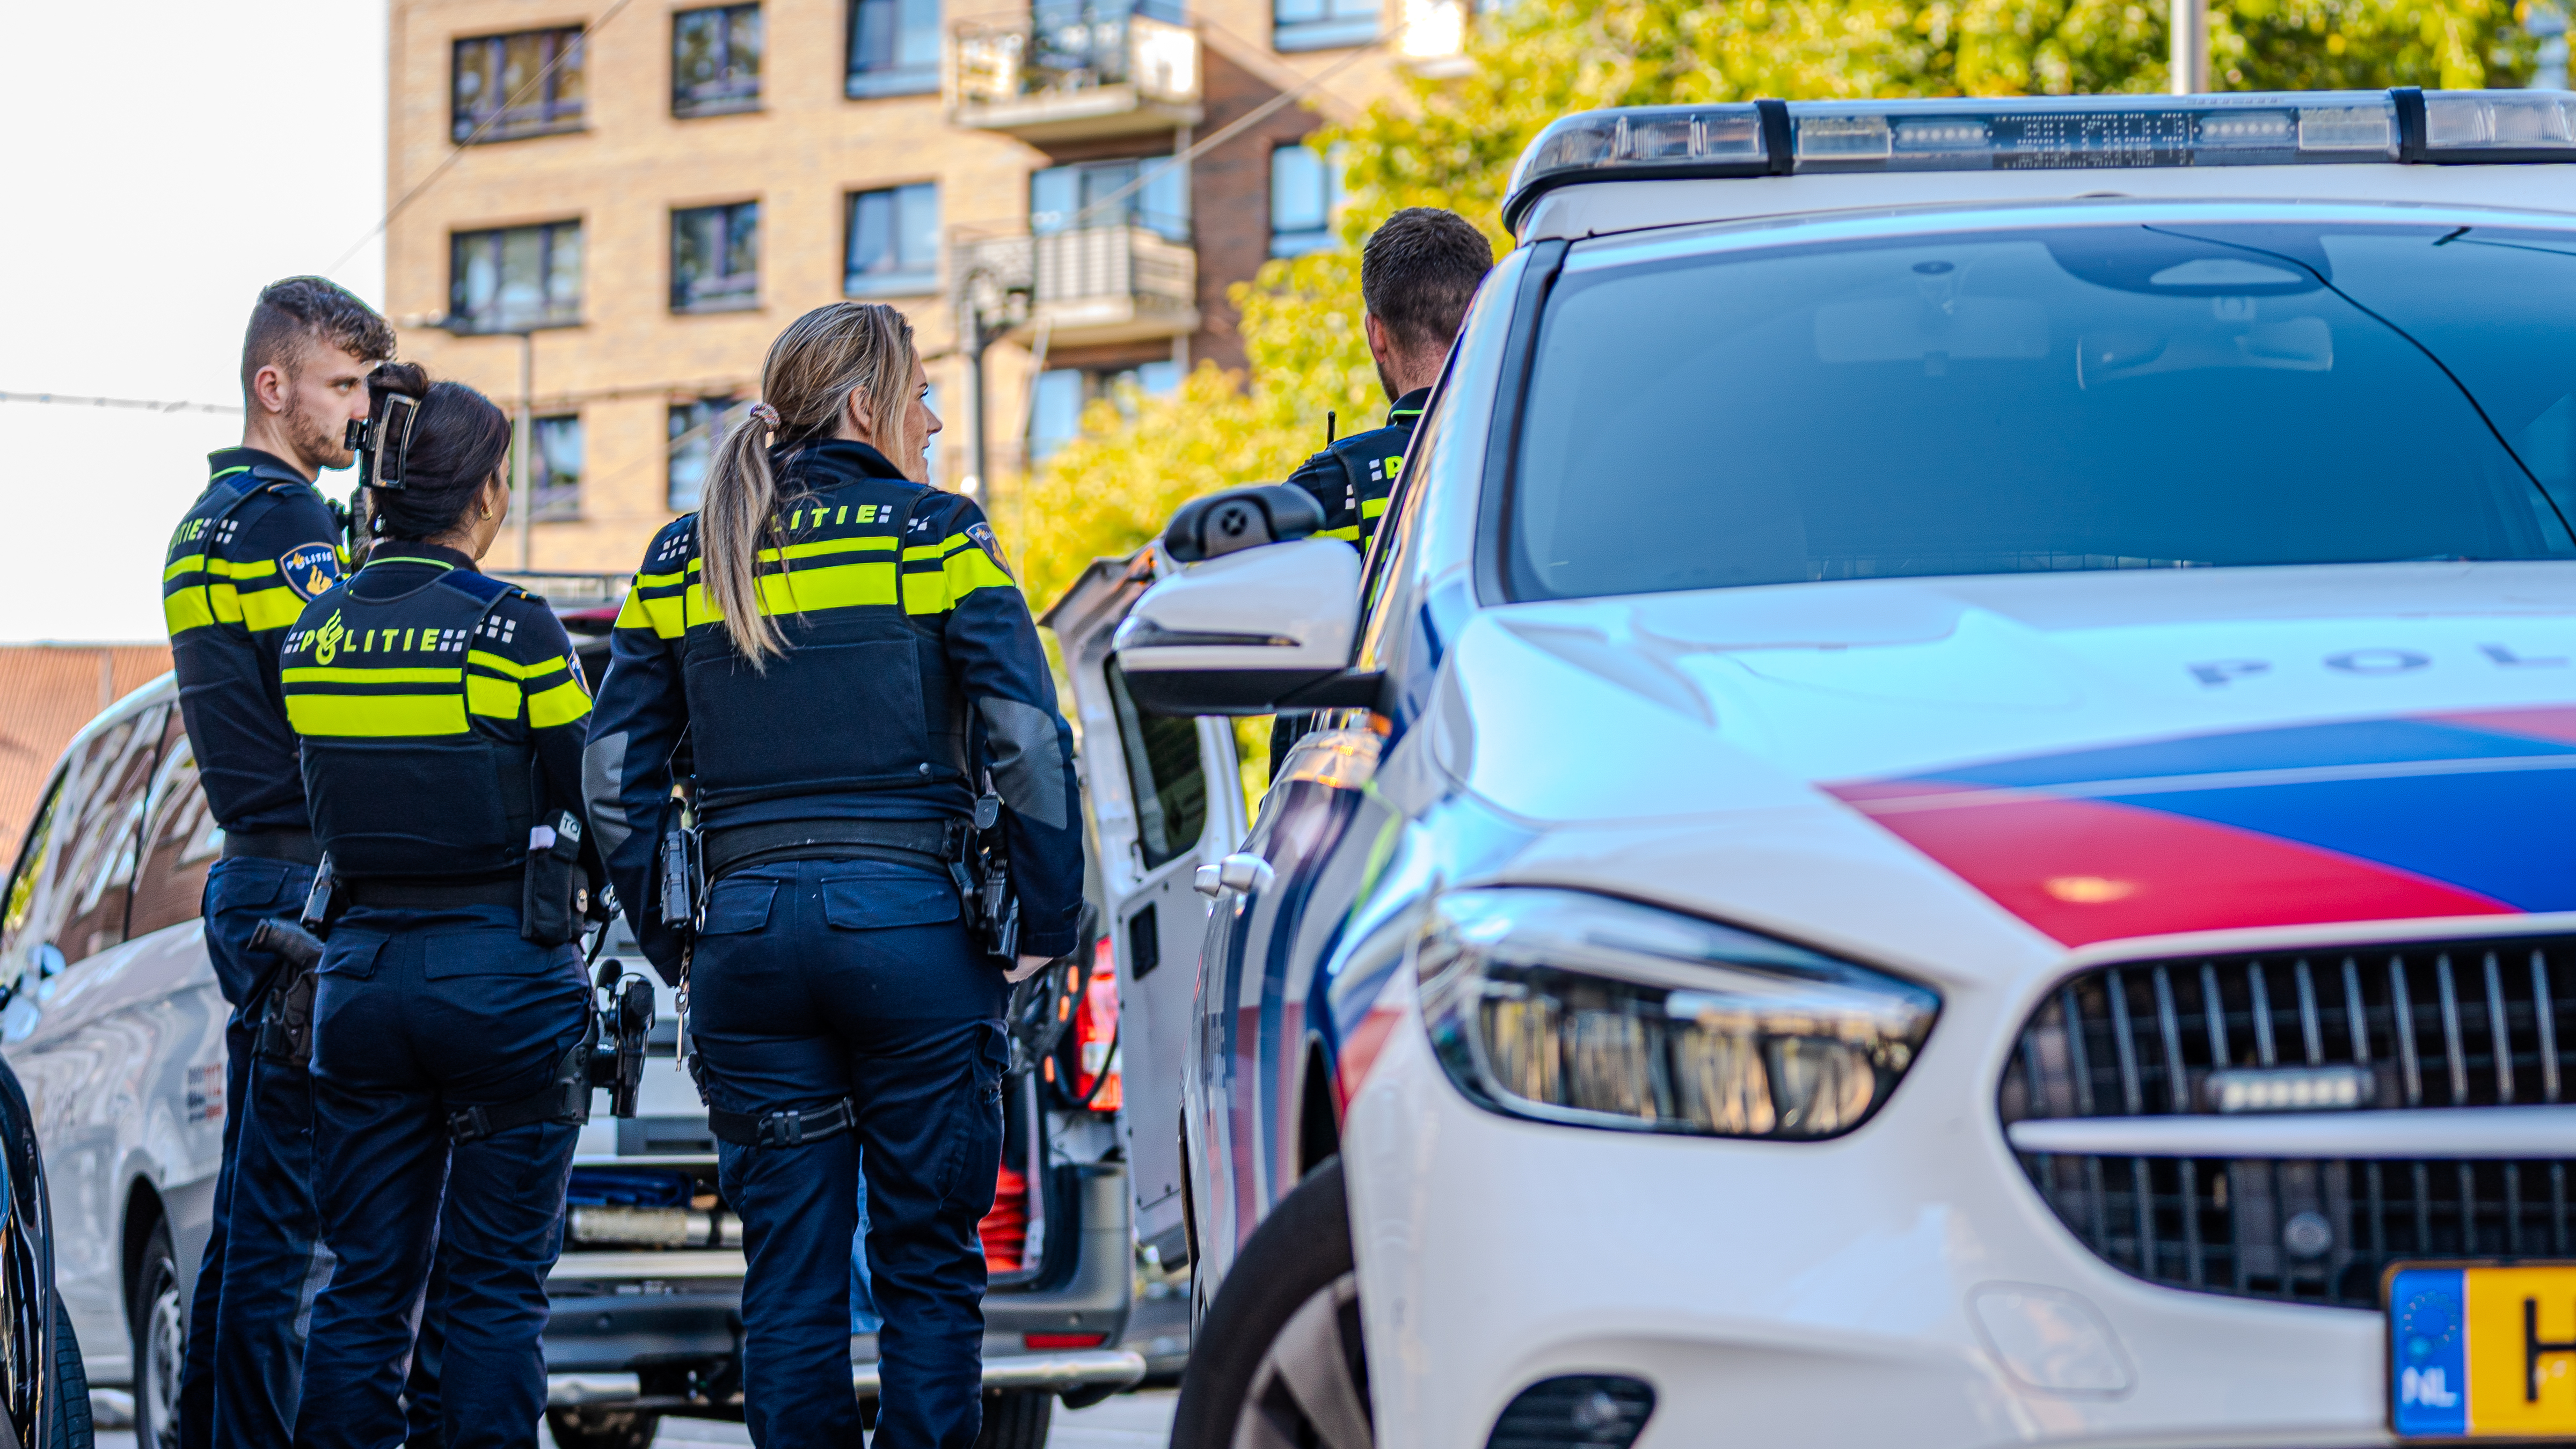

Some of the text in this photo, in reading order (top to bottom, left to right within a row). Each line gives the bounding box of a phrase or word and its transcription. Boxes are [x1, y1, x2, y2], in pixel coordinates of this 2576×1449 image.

[286, 552, 333, 570] POLITIE
[300, 627, 440, 665] POLITIE
[2187, 643, 2570, 687] POL
[2402, 1366, 2458, 1408] NL
